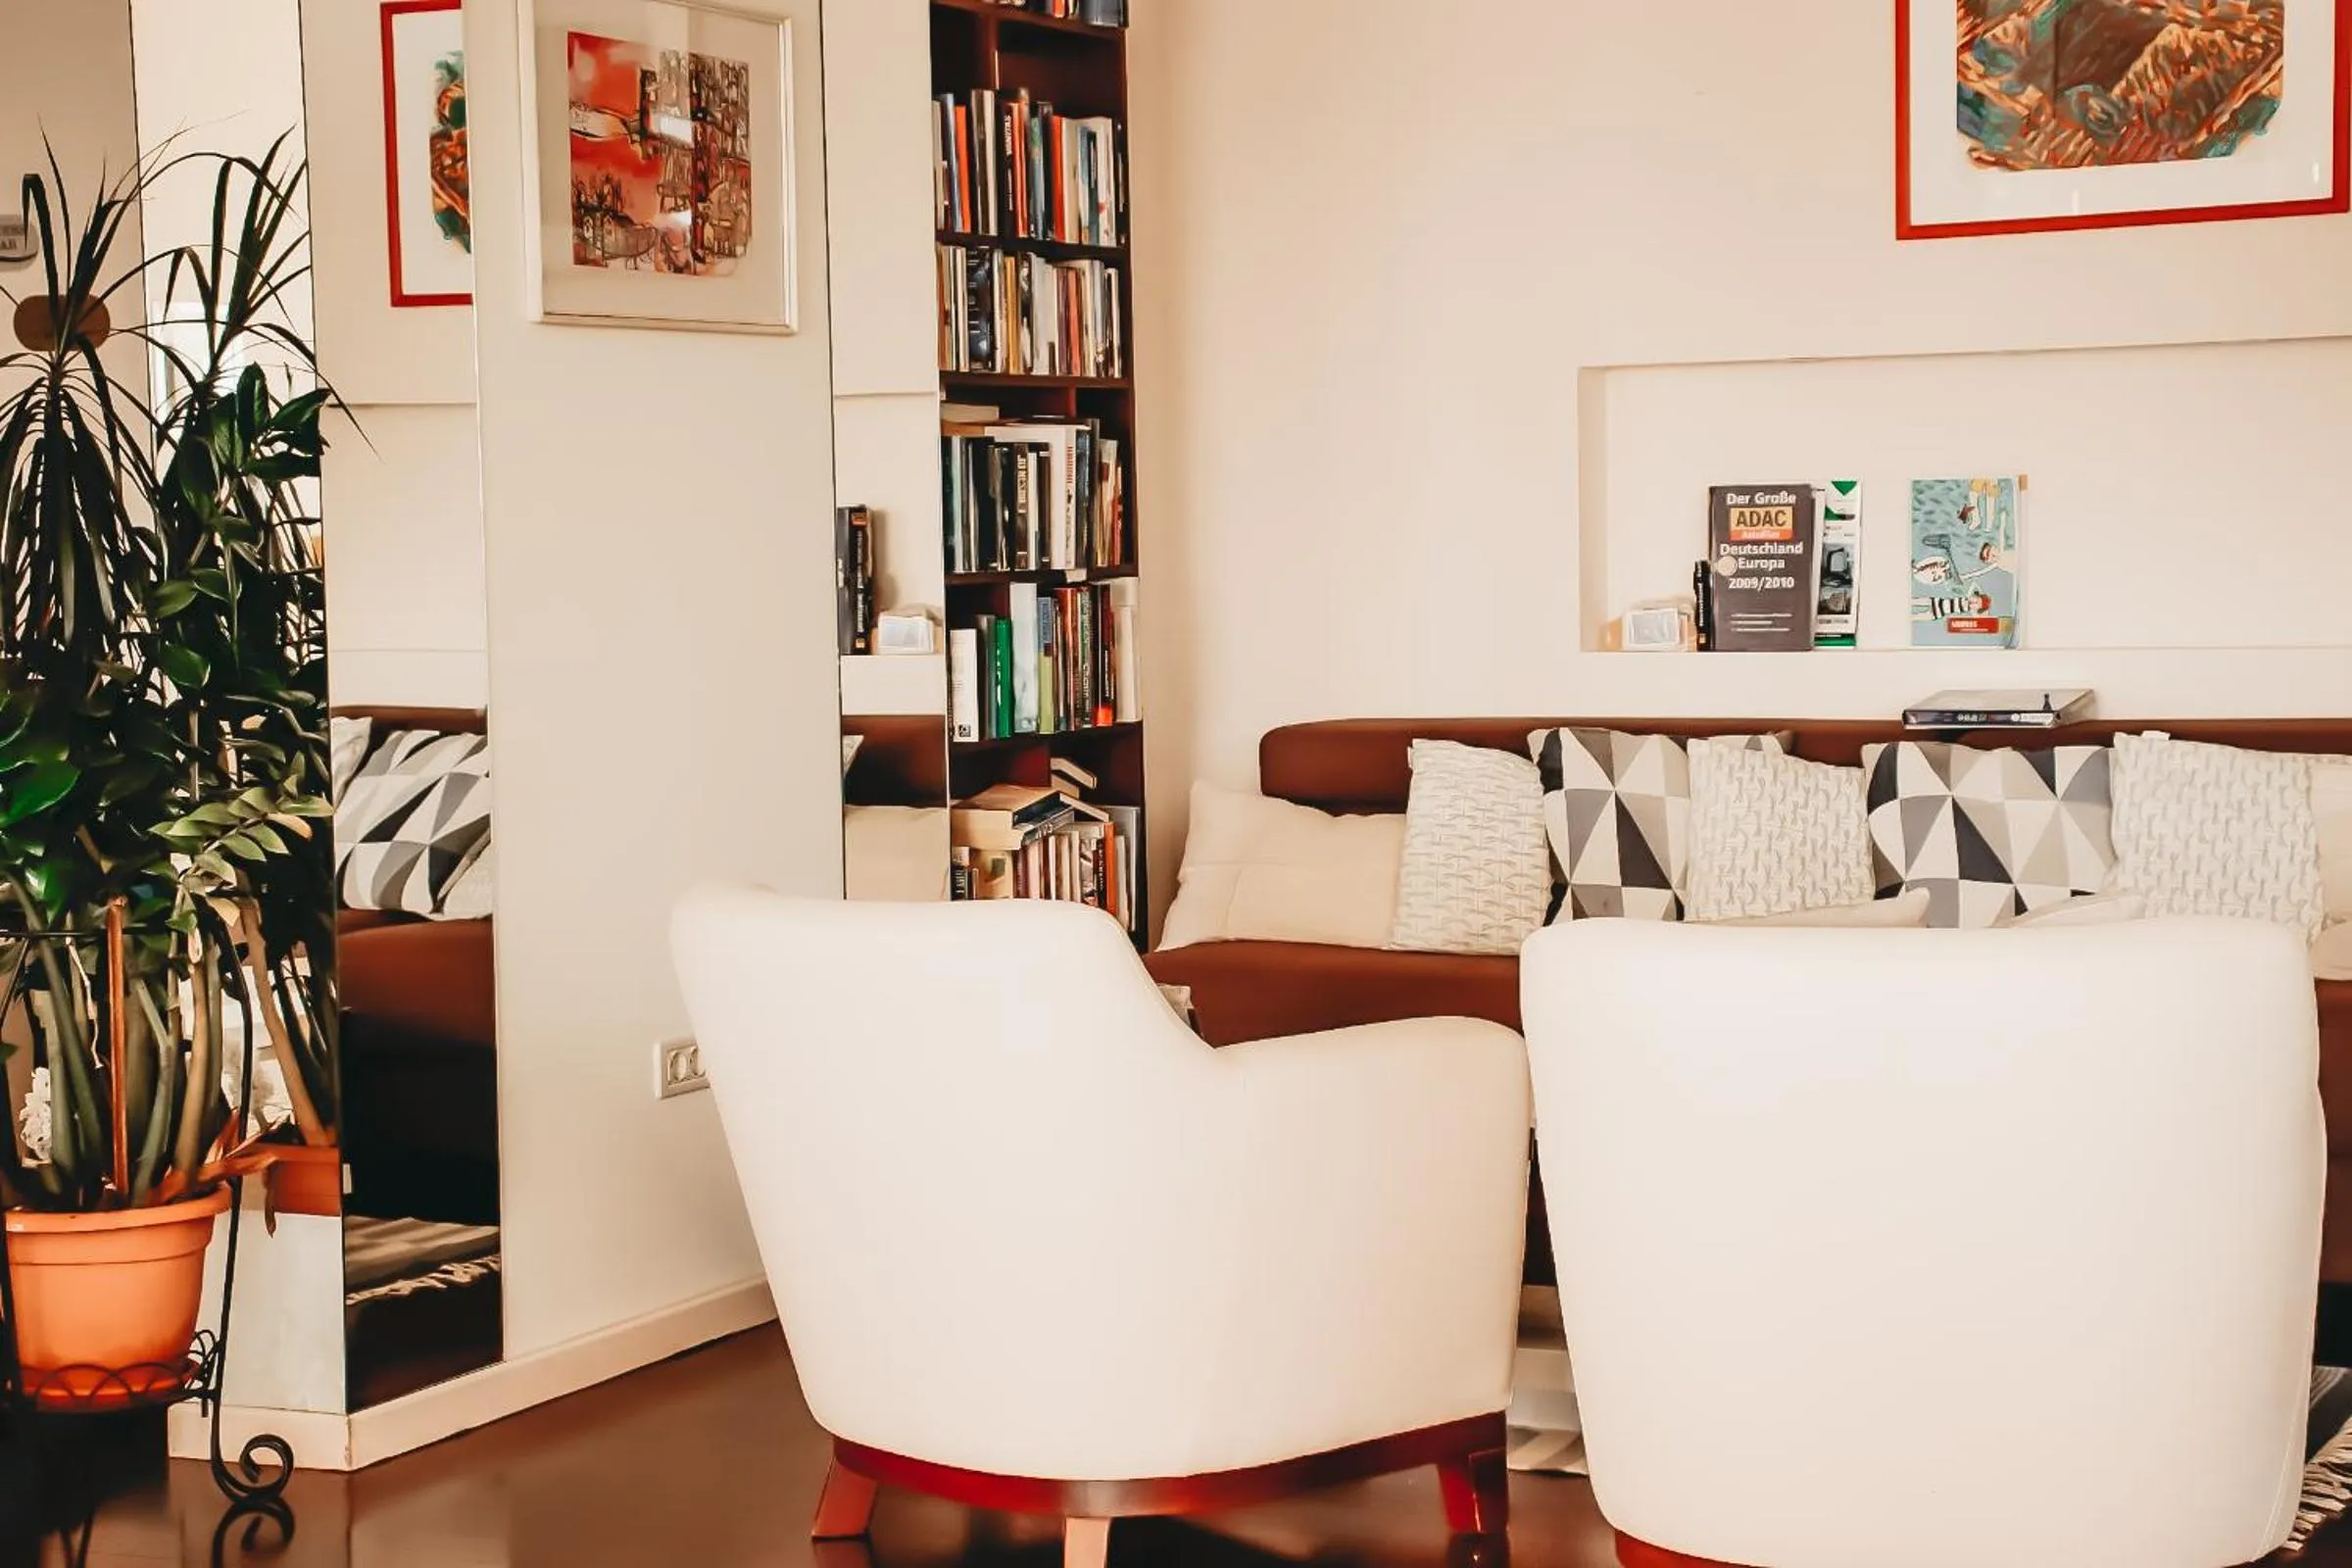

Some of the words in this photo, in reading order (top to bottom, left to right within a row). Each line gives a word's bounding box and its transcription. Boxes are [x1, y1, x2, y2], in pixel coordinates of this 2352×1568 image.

[1727, 493, 1750, 505] Der
[1754, 490, 1796, 505] Große
[1736, 510, 1787, 527] ADAC
[1720, 542, 1803, 556] Deutschland
[1738, 558, 1786, 571] Europa
[1728, 576, 1795, 591] 2009/2010
